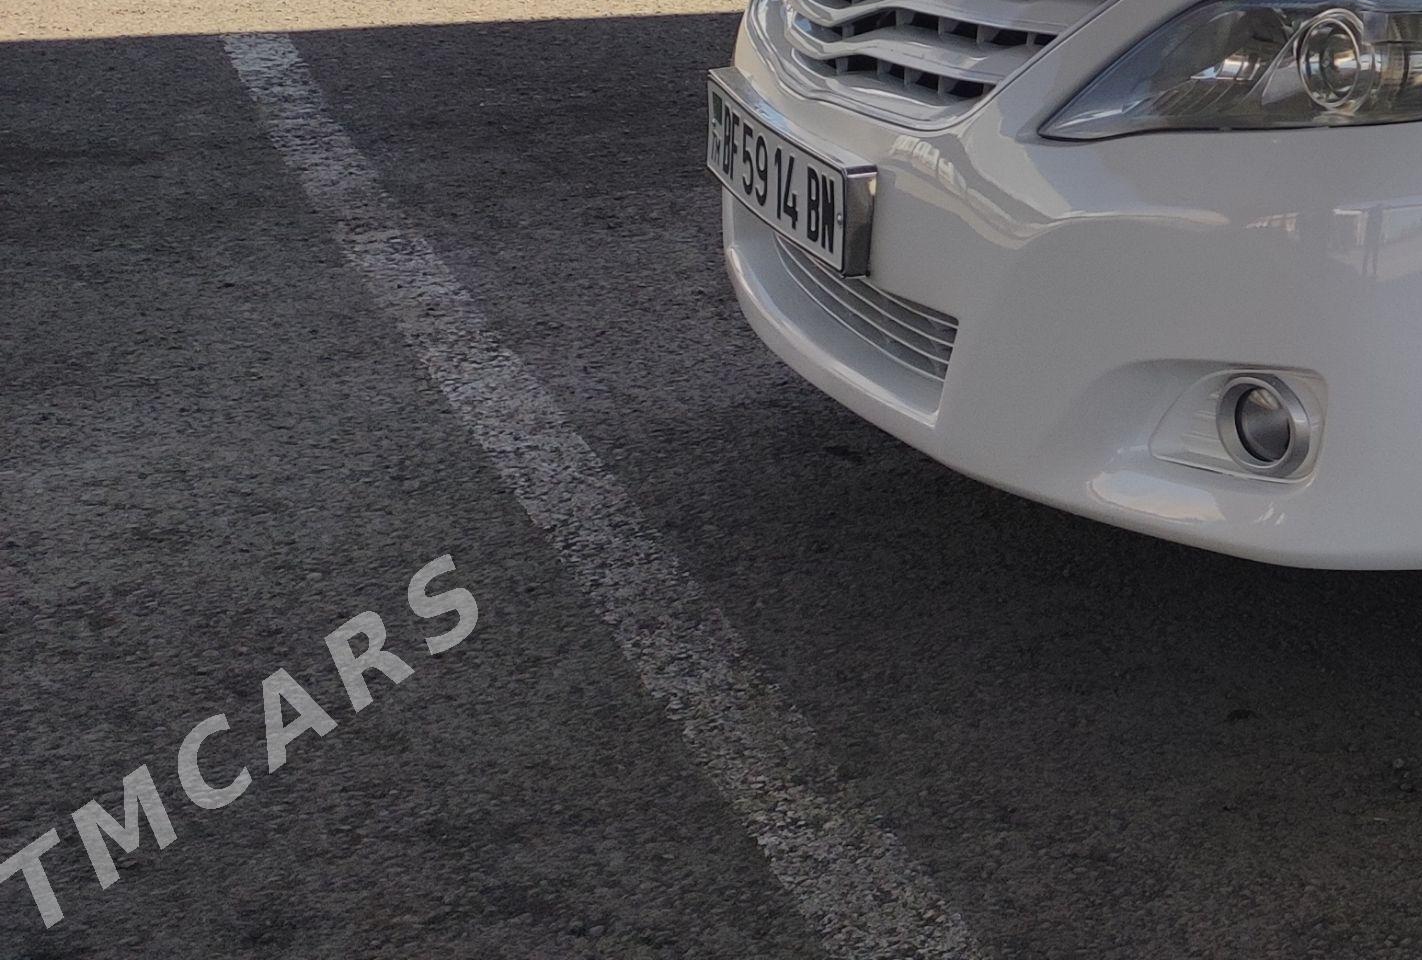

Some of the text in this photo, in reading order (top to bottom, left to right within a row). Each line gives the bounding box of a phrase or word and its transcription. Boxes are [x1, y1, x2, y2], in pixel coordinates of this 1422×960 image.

[723, 104, 835, 255] BF 59 14 BN
